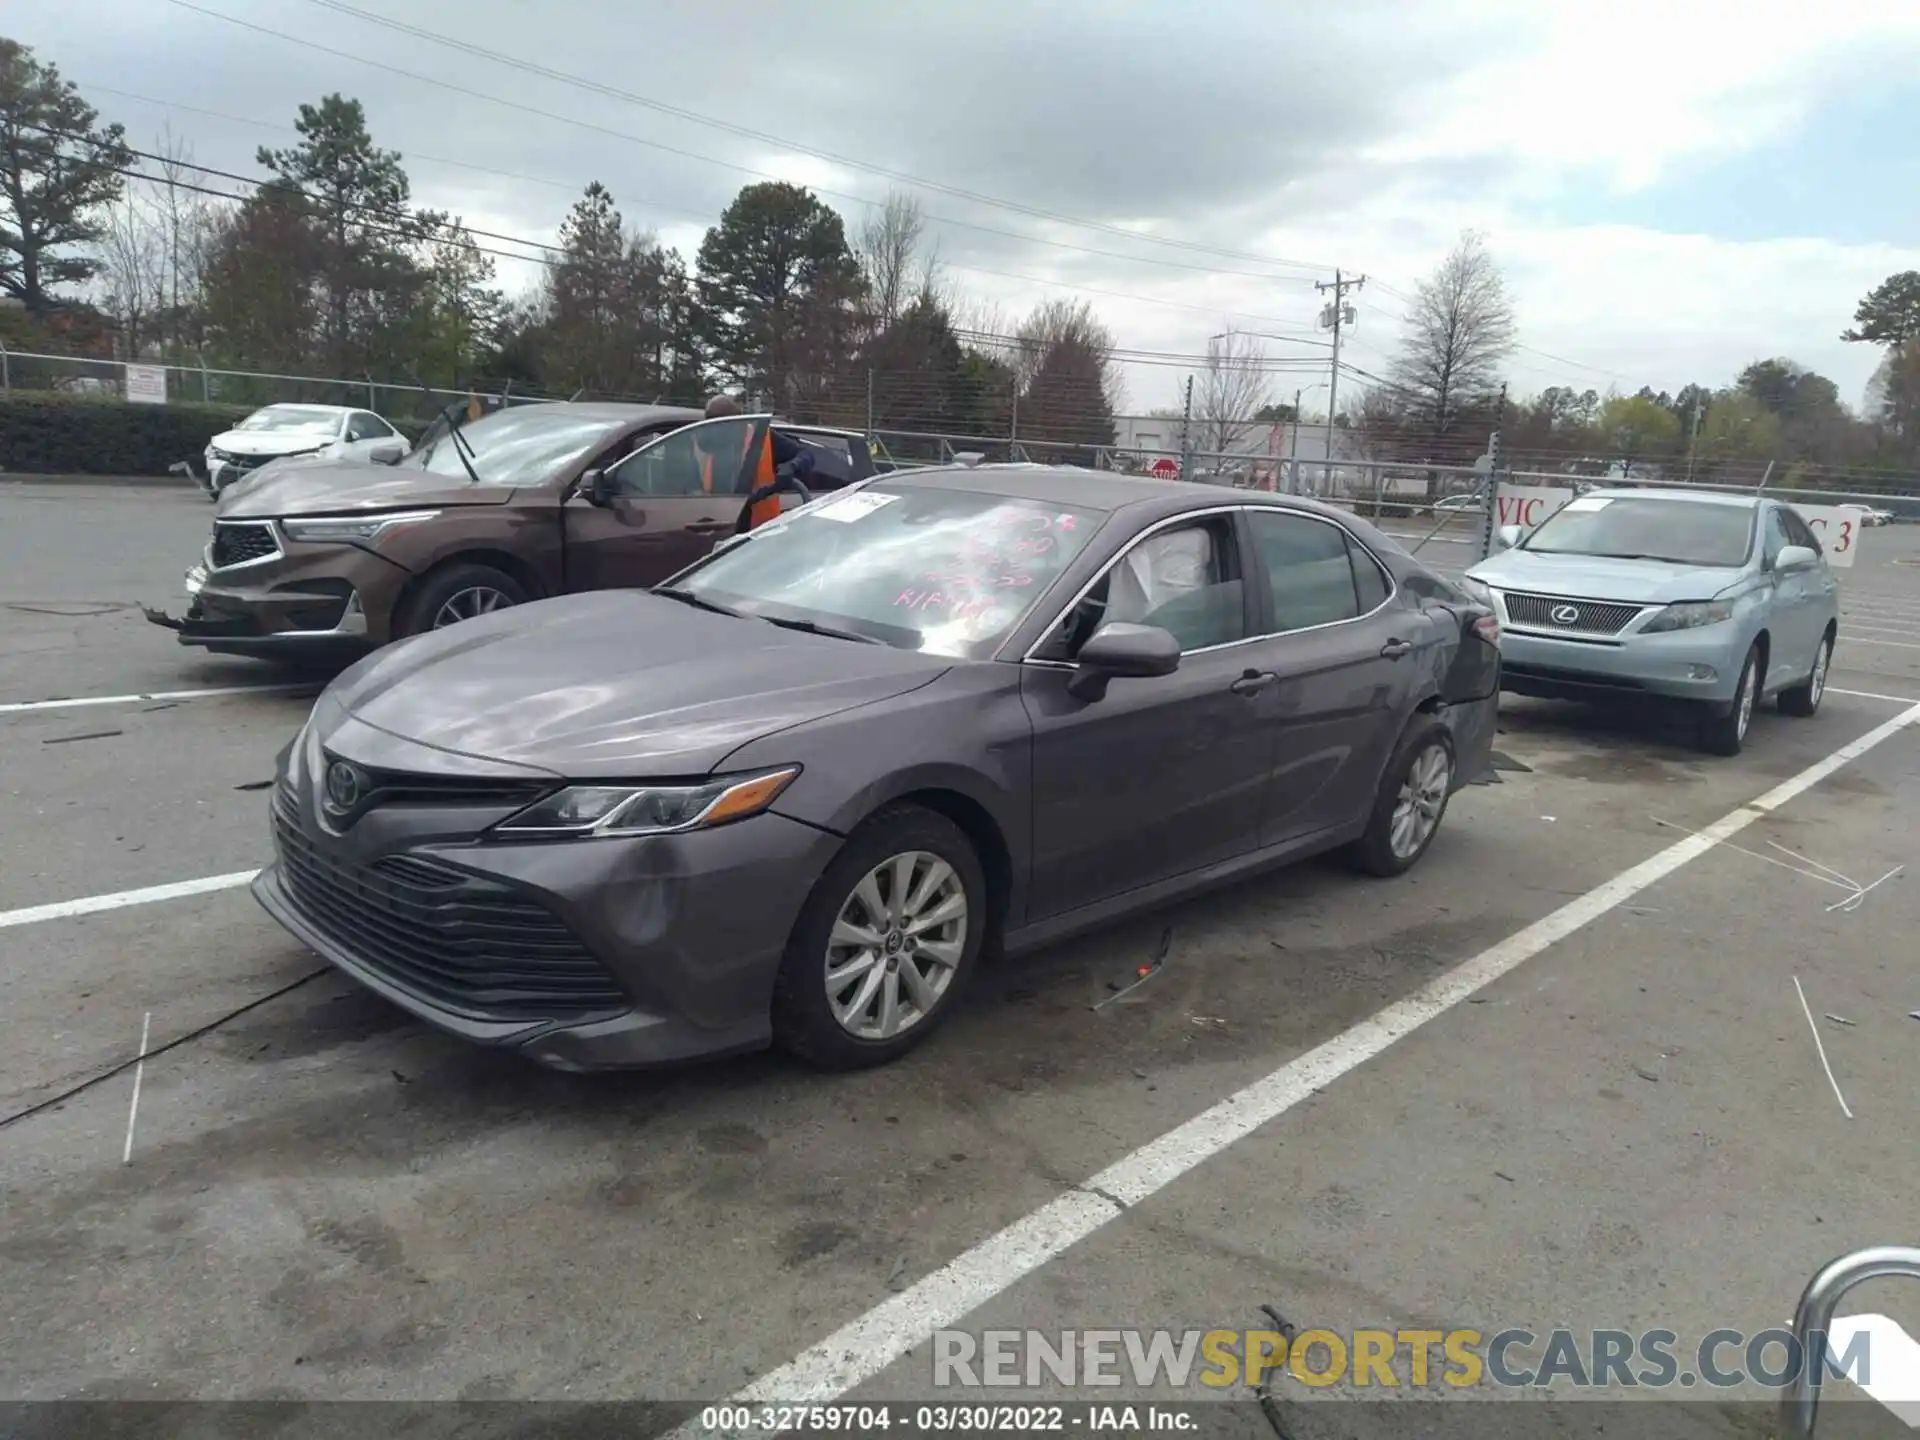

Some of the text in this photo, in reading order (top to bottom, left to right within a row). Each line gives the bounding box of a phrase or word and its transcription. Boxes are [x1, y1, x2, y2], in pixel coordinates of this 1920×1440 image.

[1153, 469, 1177, 480] STOP
[1496, 497, 1545, 528] VIC
[1833, 520, 1852, 553] 3
